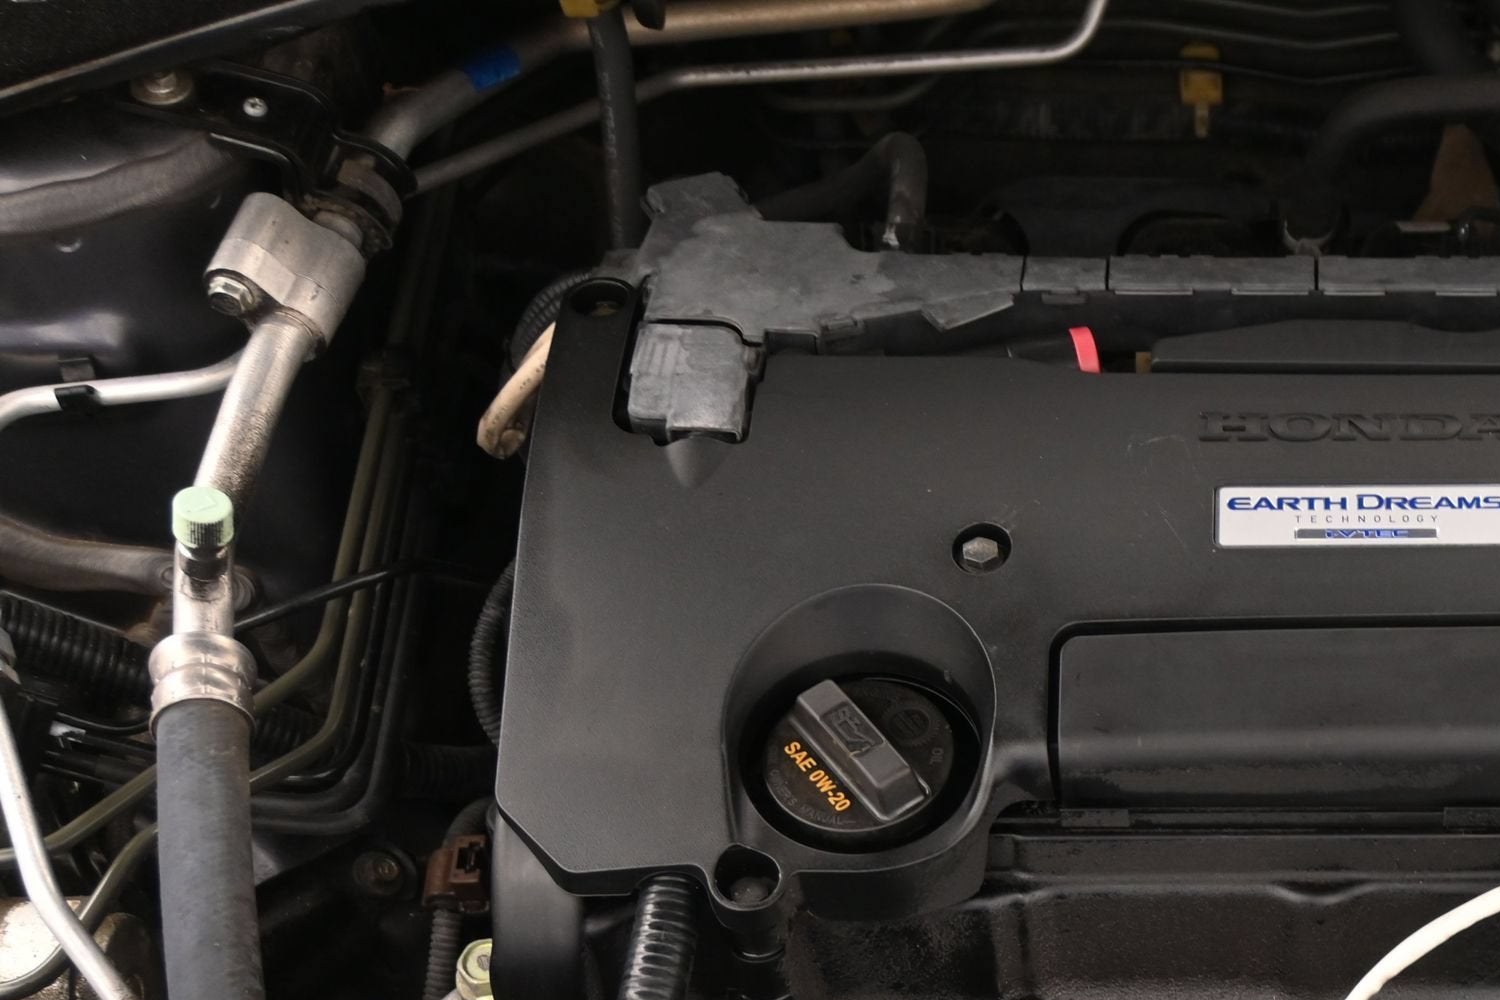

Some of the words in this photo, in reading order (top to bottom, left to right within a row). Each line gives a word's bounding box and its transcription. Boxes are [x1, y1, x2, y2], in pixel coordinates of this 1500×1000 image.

[1226, 496, 1347, 511] EARTH
[1295, 514, 1439, 524] TECHNOLOGY
[784, 741, 817, 772] SAE
[808, 769, 851, 812] 0W-20
